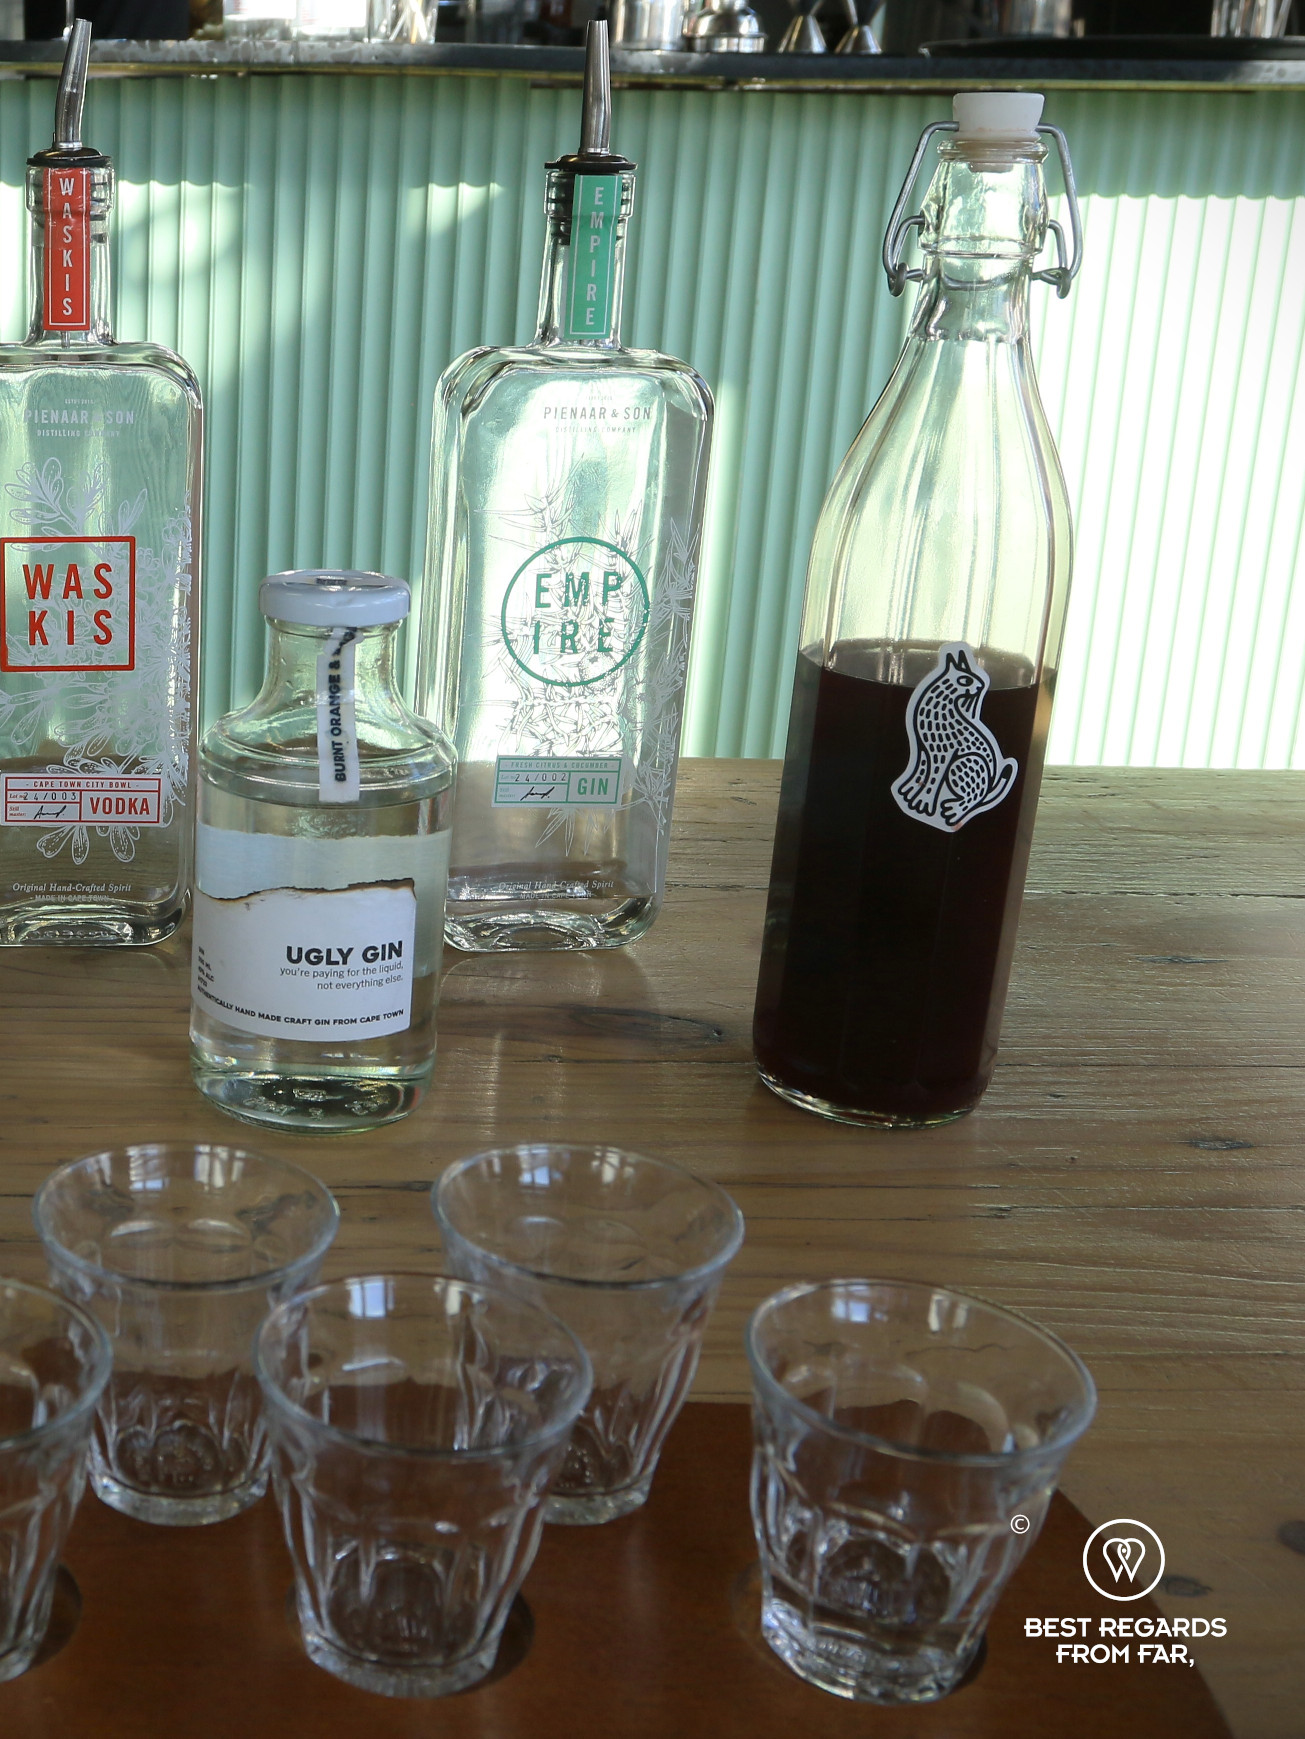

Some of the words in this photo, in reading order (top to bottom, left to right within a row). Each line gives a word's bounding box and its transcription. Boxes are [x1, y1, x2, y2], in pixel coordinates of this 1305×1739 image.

[59, 177, 75, 317] WASKIS
[585, 186, 604, 326] EMPIRE
[24, 409, 89, 424] PIENAAR
[106, 410, 134, 424] SON
[543, 406, 607, 420] PIENAAR
[611, 408, 619, 418] &
[623, 406, 651, 420] SON
[37, 429, 81, 437] DISTILLING
[22, 562, 113, 600] WAS
[534, 571, 623, 609] EMP
[28, 609, 113, 646] KIS
[532, 617, 615, 655] IRE
[328, 659, 341, 670] &
[328, 673, 342, 737] ORANGE
[331, 740, 347, 782] BURNT
[33, 780, 55, 788] CAPE
[109, 781, 132, 789] BOWL
[577, 777, 609, 796] GIN
[89, 796, 150, 815] VODKA
[12, 882, 46, 893] Original
[49, 882, 106, 893] Hand-Crafted
[108, 883, 132, 893] Spirit
[591, 880, 614, 889] Spirit
[286, 945, 354, 966] UGLY
[361, 940, 403, 964] GIN
[279, 966, 310, 978] you're
[312, 967, 345, 979] paying
[347, 966, 360, 977] for
[362, 965, 377, 976] the
[379, 961, 404, 974] liquid,
[316, 981, 333, 990] not
[335, 978, 384, 991] everything
[385, 974, 403, 985] else.
[234, 1005, 256, 1017] HAND
[258, 1012, 282, 1022] MADE
[284, 1016, 311, 1026] CRAFT
[314, 1017, 331, 1026] GIN
[332, 1016, 358, 1025] FROM
[359, 1014, 380, 1023] CAPE
[382, 1008, 404, 1020] TOWN
